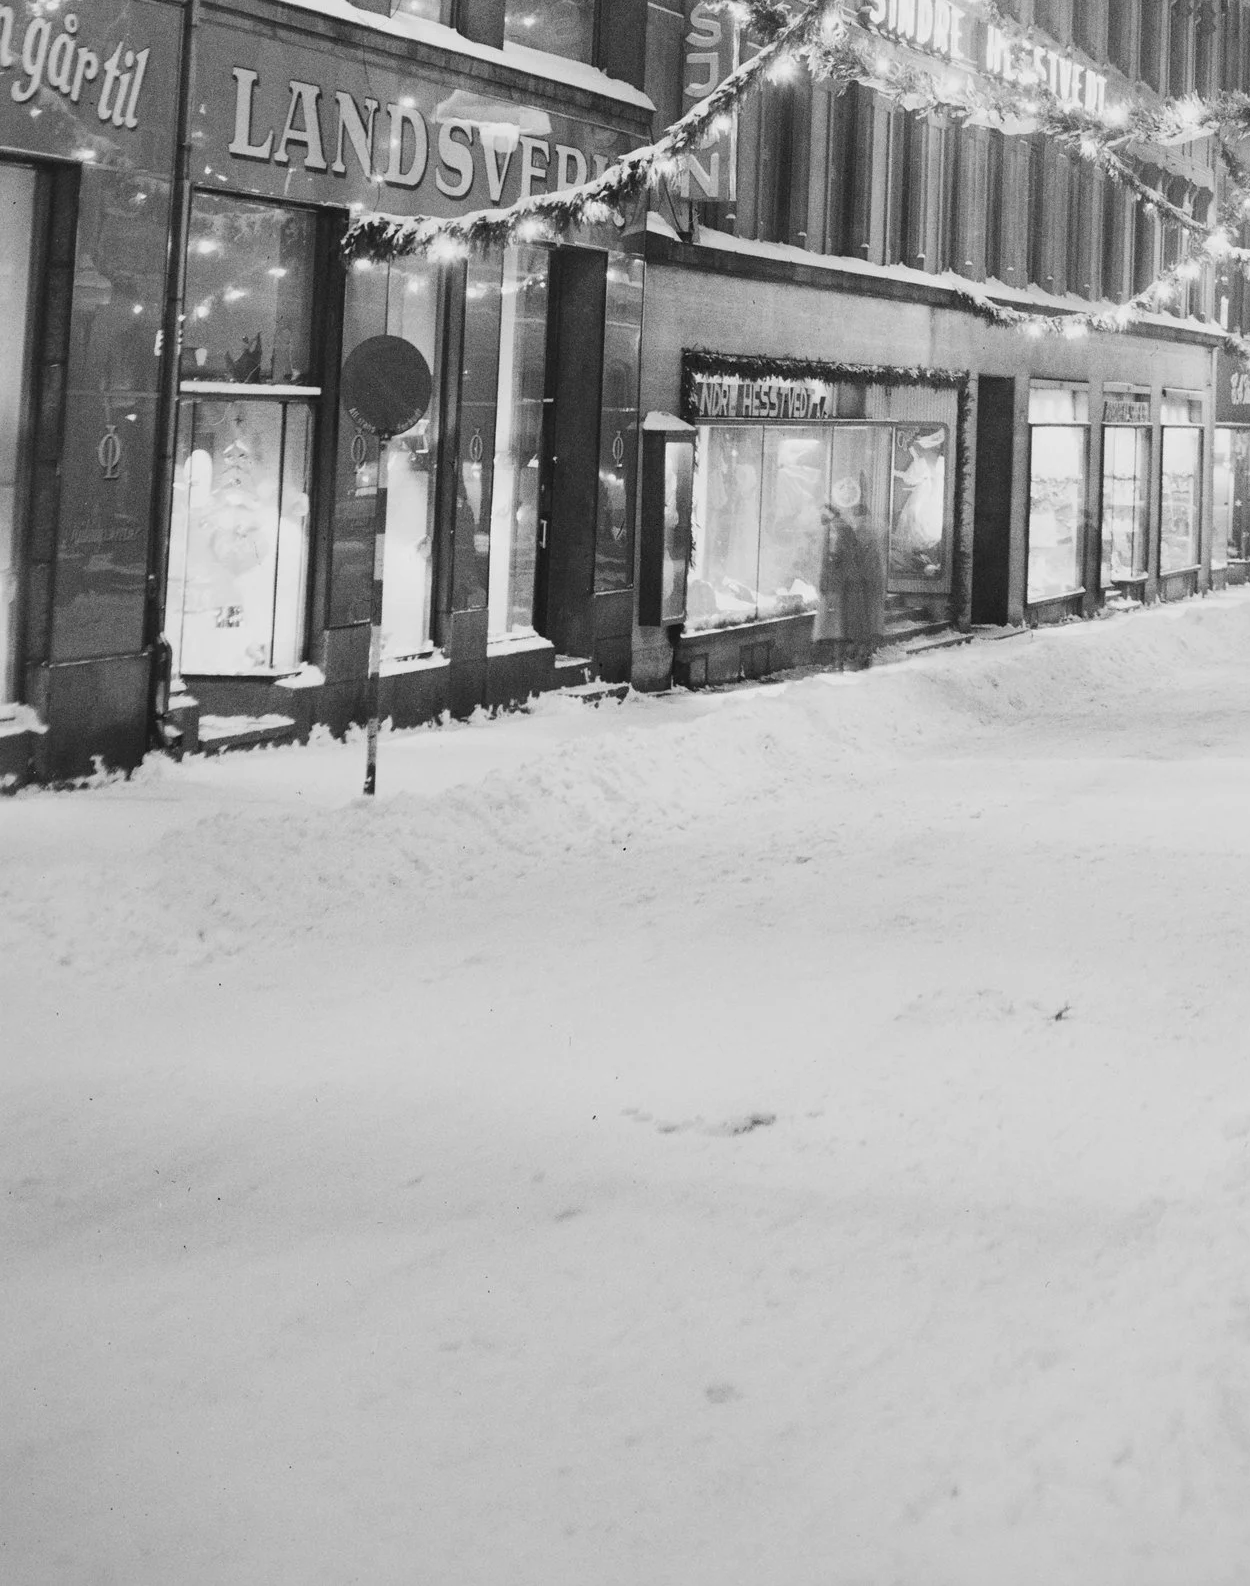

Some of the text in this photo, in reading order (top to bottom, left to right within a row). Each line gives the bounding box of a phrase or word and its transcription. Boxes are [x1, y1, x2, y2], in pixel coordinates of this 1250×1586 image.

[11, 13, 98, 102] går
[97, 41, 151, 128] til
[228, 66, 620, 220] LANDSVER
[698, 381, 738, 416] NDRE
